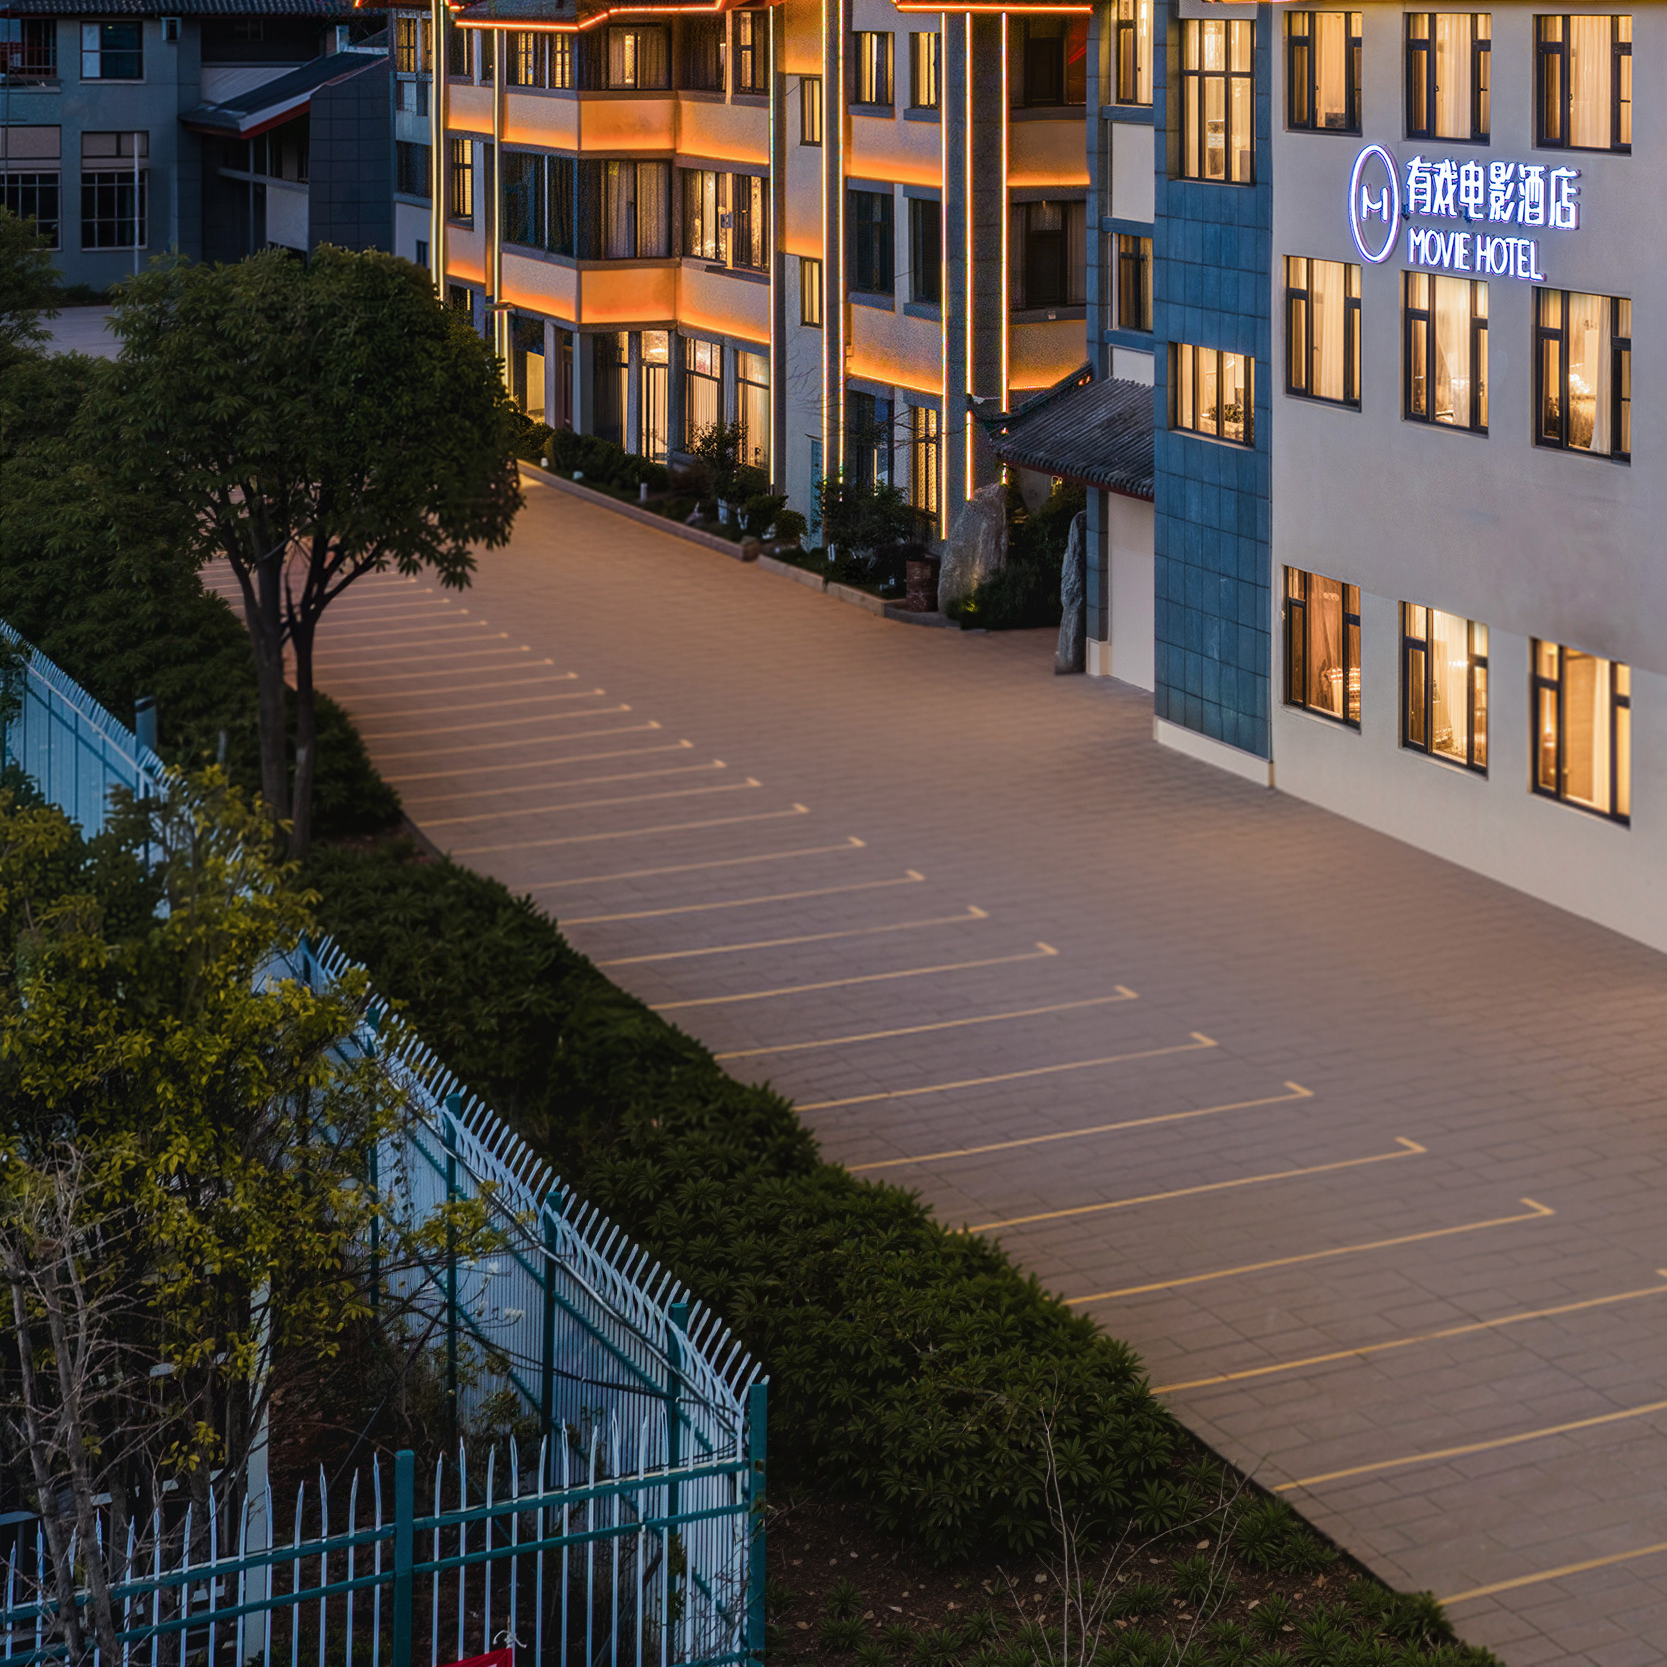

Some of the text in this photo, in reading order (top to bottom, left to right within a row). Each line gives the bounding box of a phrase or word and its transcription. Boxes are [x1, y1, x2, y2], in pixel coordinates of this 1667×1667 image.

[1406, 155, 1579, 229] 有戏电影酒店
[1409, 229, 1547, 281] MOVIE HOTEL
